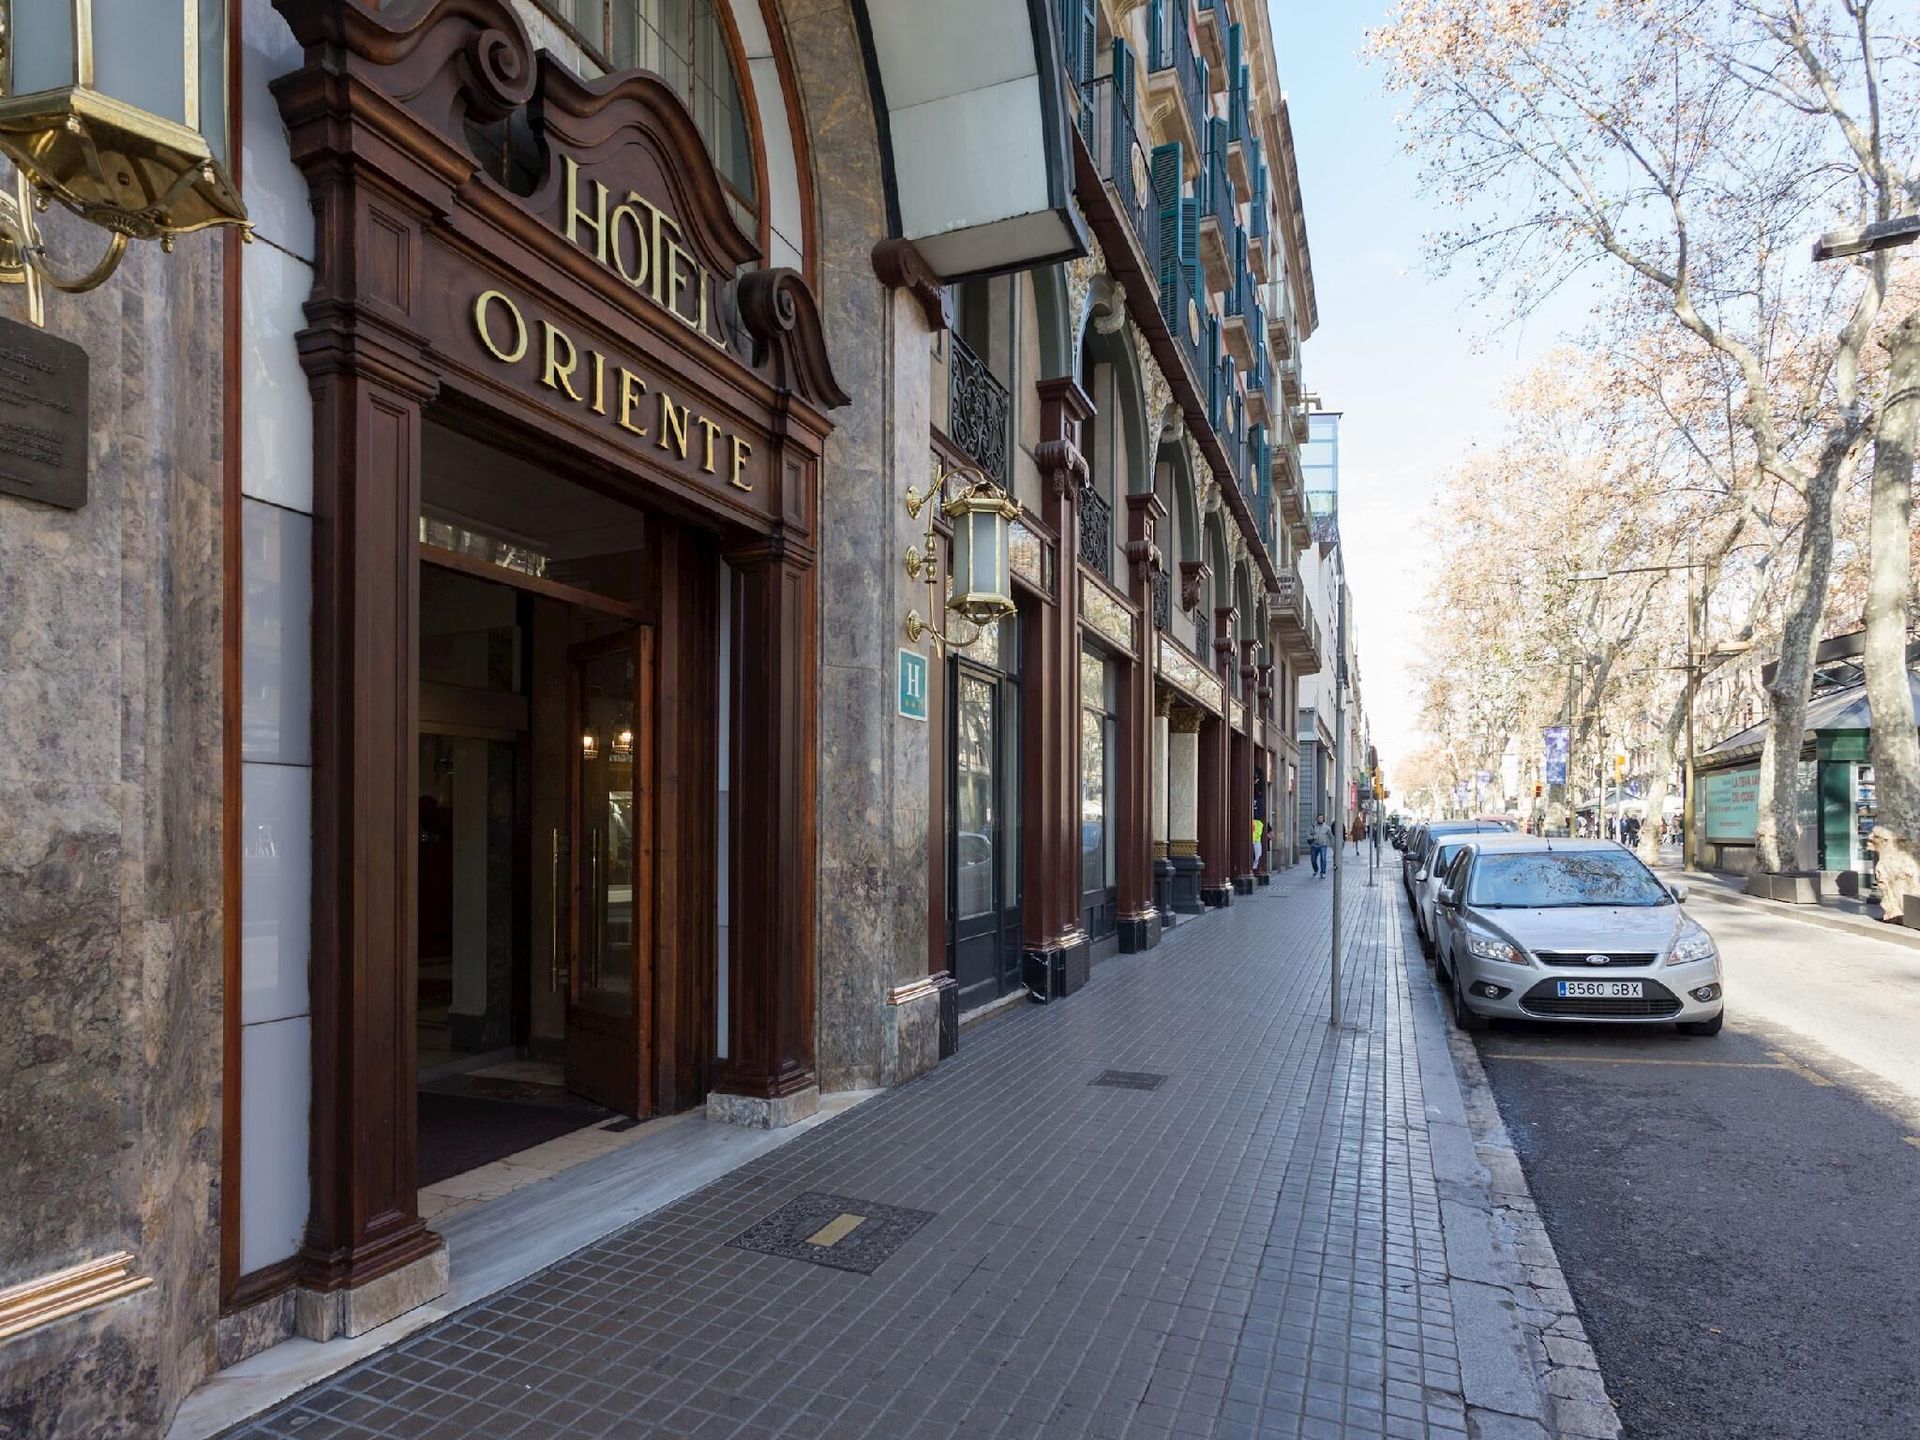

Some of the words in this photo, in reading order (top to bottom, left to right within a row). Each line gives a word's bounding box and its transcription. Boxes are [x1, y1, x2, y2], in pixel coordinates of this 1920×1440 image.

[561, 154, 727, 350] HOTEL
[474, 290, 753, 492] ORIENTE
[906, 662, 920, 698] H
[1568, 983, 1605, 996] 8560
[1612, 983, 1639, 996] GBX
